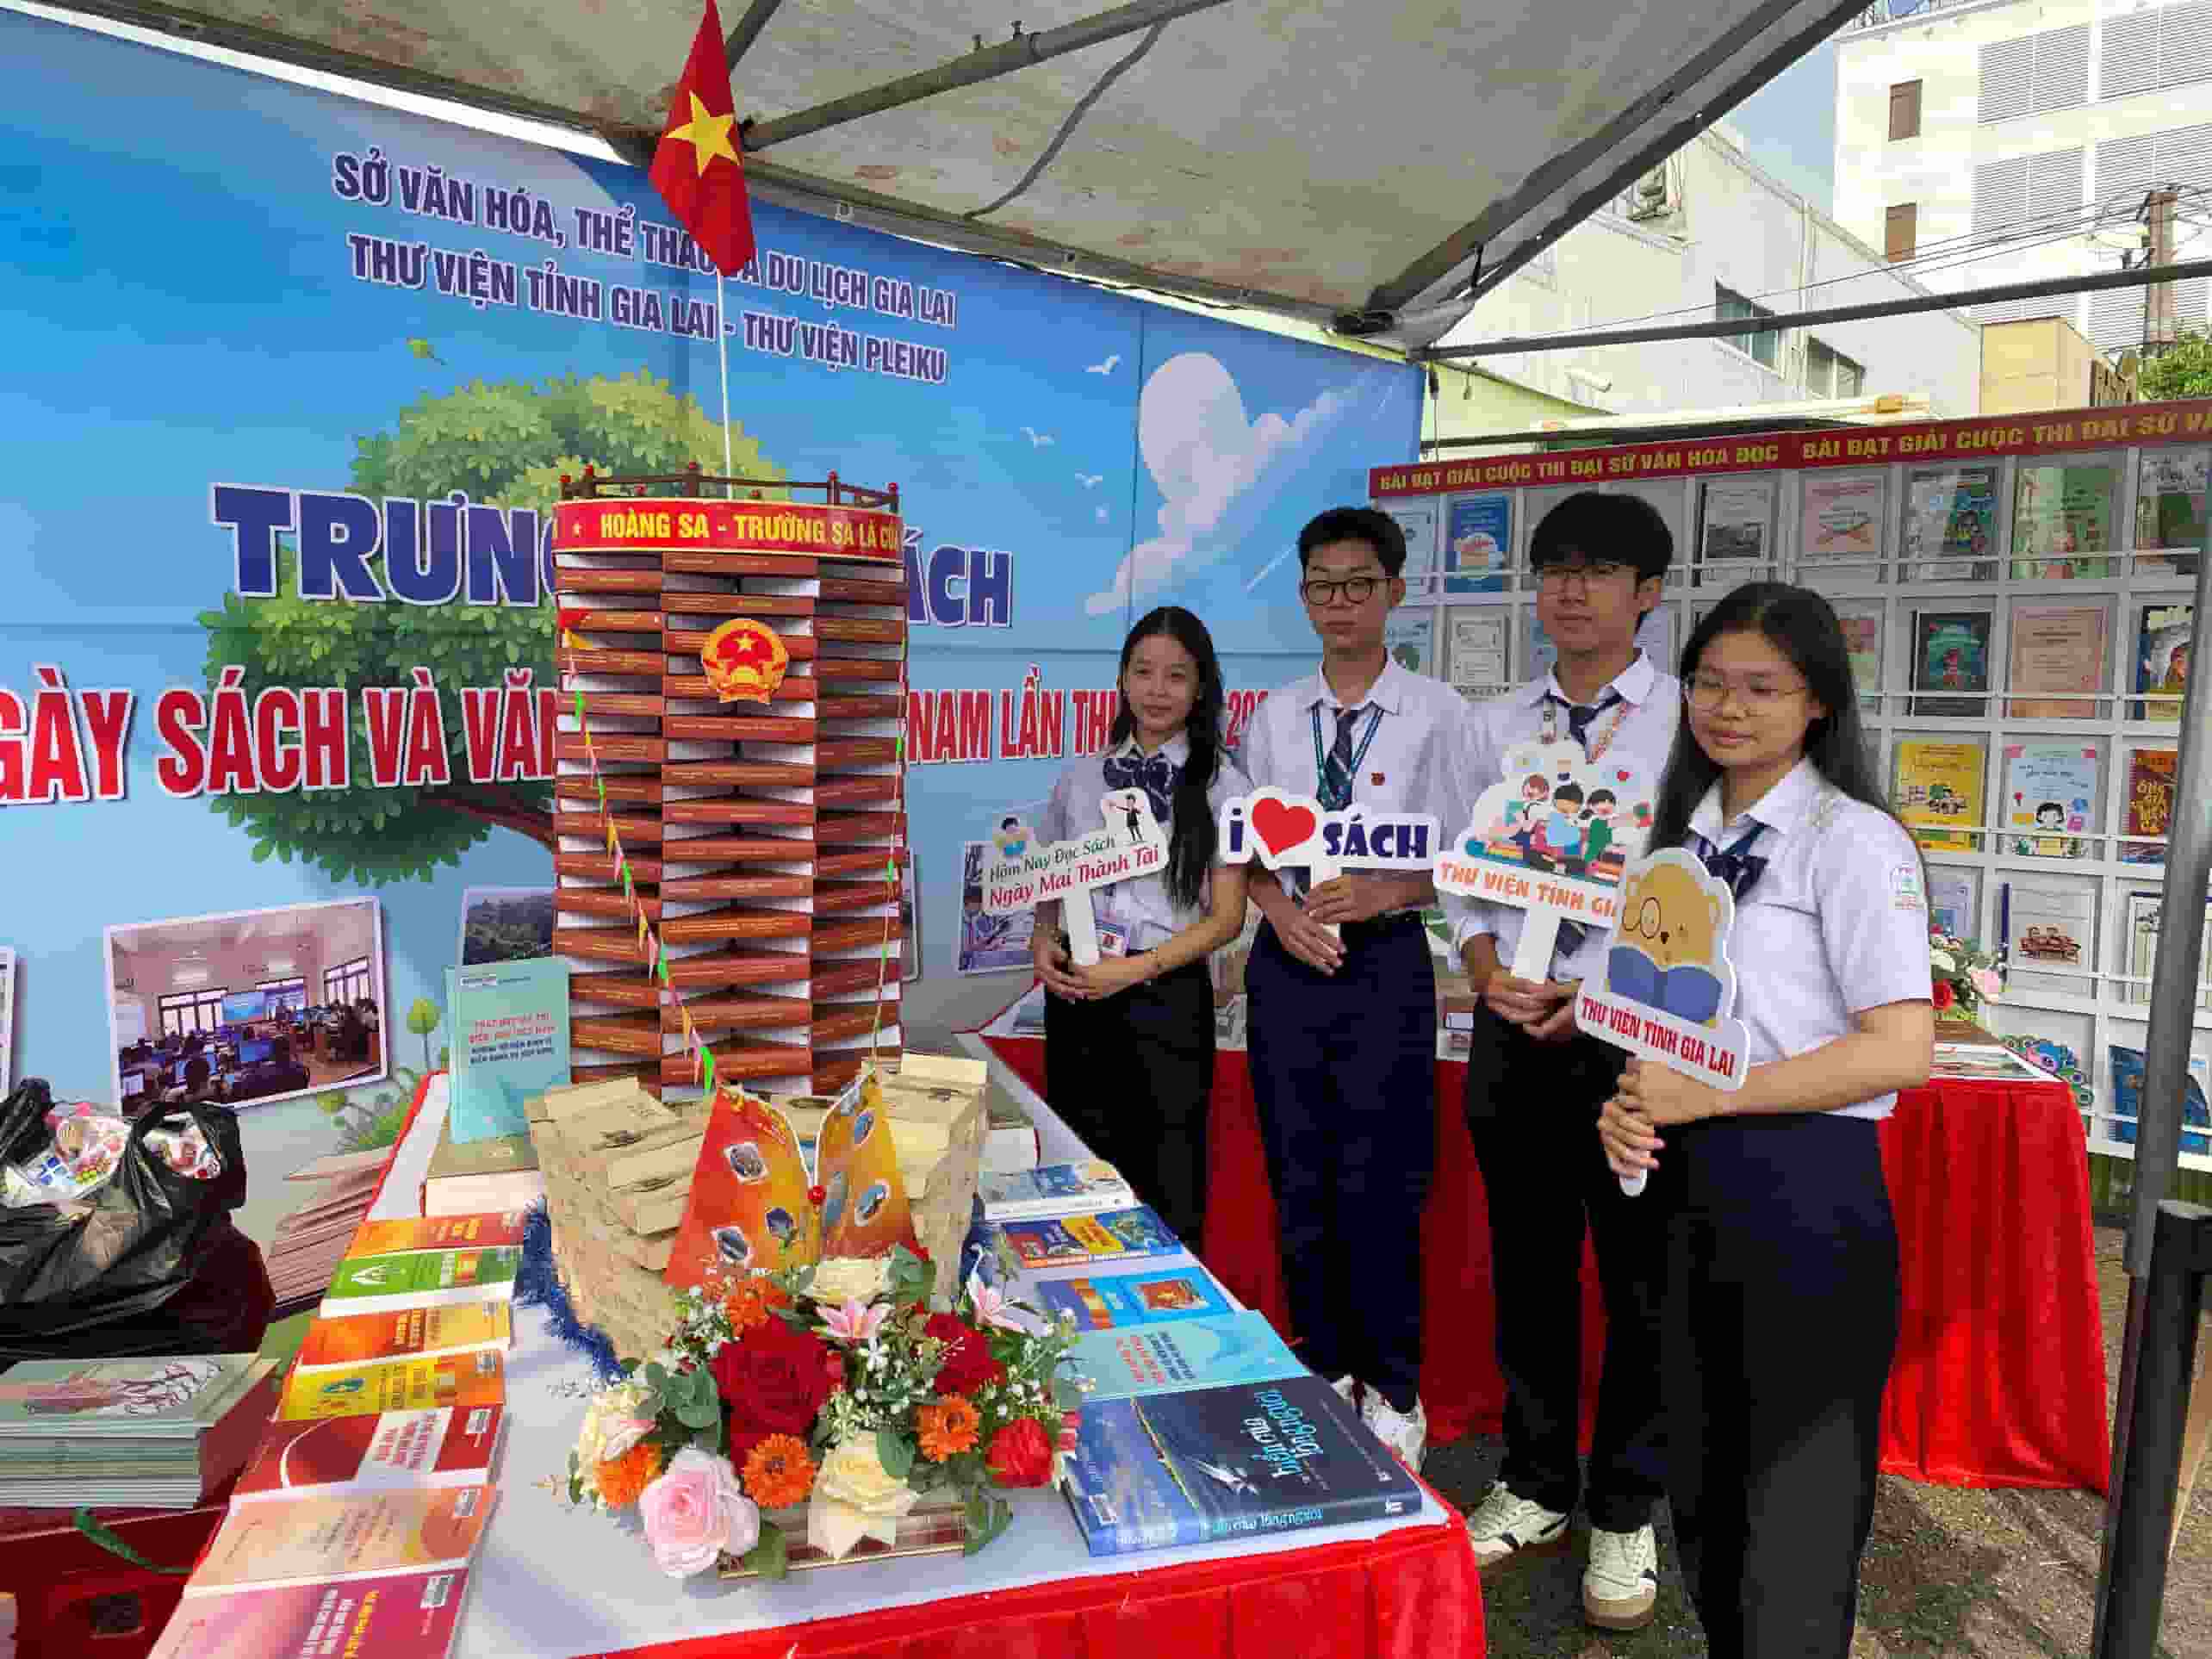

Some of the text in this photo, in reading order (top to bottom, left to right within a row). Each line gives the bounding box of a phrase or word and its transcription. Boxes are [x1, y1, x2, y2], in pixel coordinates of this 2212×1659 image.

[334, 146, 391, 205] SỞ
[399, 165, 475, 224] VĂN
[482, 186, 566, 248] HÓA,
[575, 203, 635, 259] THỂ
[767, 251, 805, 295] DU
[811, 262, 869, 310] LỊCH
[873, 276, 914, 318] GIA
[918, 287, 957, 329] LAI
[346, 233, 429, 289] THƯ
[432, 249, 518, 309] VIỆN
[525, 258, 601, 322] TỈNH
[611, 284, 663, 332] GIA
[669, 295, 717, 344] LAI
[742, 310, 798, 357] THƯ
[800, 320, 860, 372] VIỆN
[864, 335, 948, 385] PLEIKU
[600, 506, 671, 539] HOÀNG
[678, 513, 711, 539] SA
[733, 510, 827, 545] TRƯỜNG
[831, 521, 855, 546] SA
[157, 664, 350, 798] SÁCH
[362, 666, 450, 786] VÀ
[908, 688, 992, 765] NAM
[998, 662, 1064, 759] LẦN
[1082, 834, 1117, 855] Sách
[1322, 812, 1429, 859] SÁCH
[990, 882, 1035, 908] Ngày
[1040, 870, 1074, 894] Mai
[1077, 853, 1131, 883] Thành
[1590, 896, 1614, 916] GI
[1681, 1035, 1706, 1067] GIA
[1707, 1045, 1737, 1078] LAI
